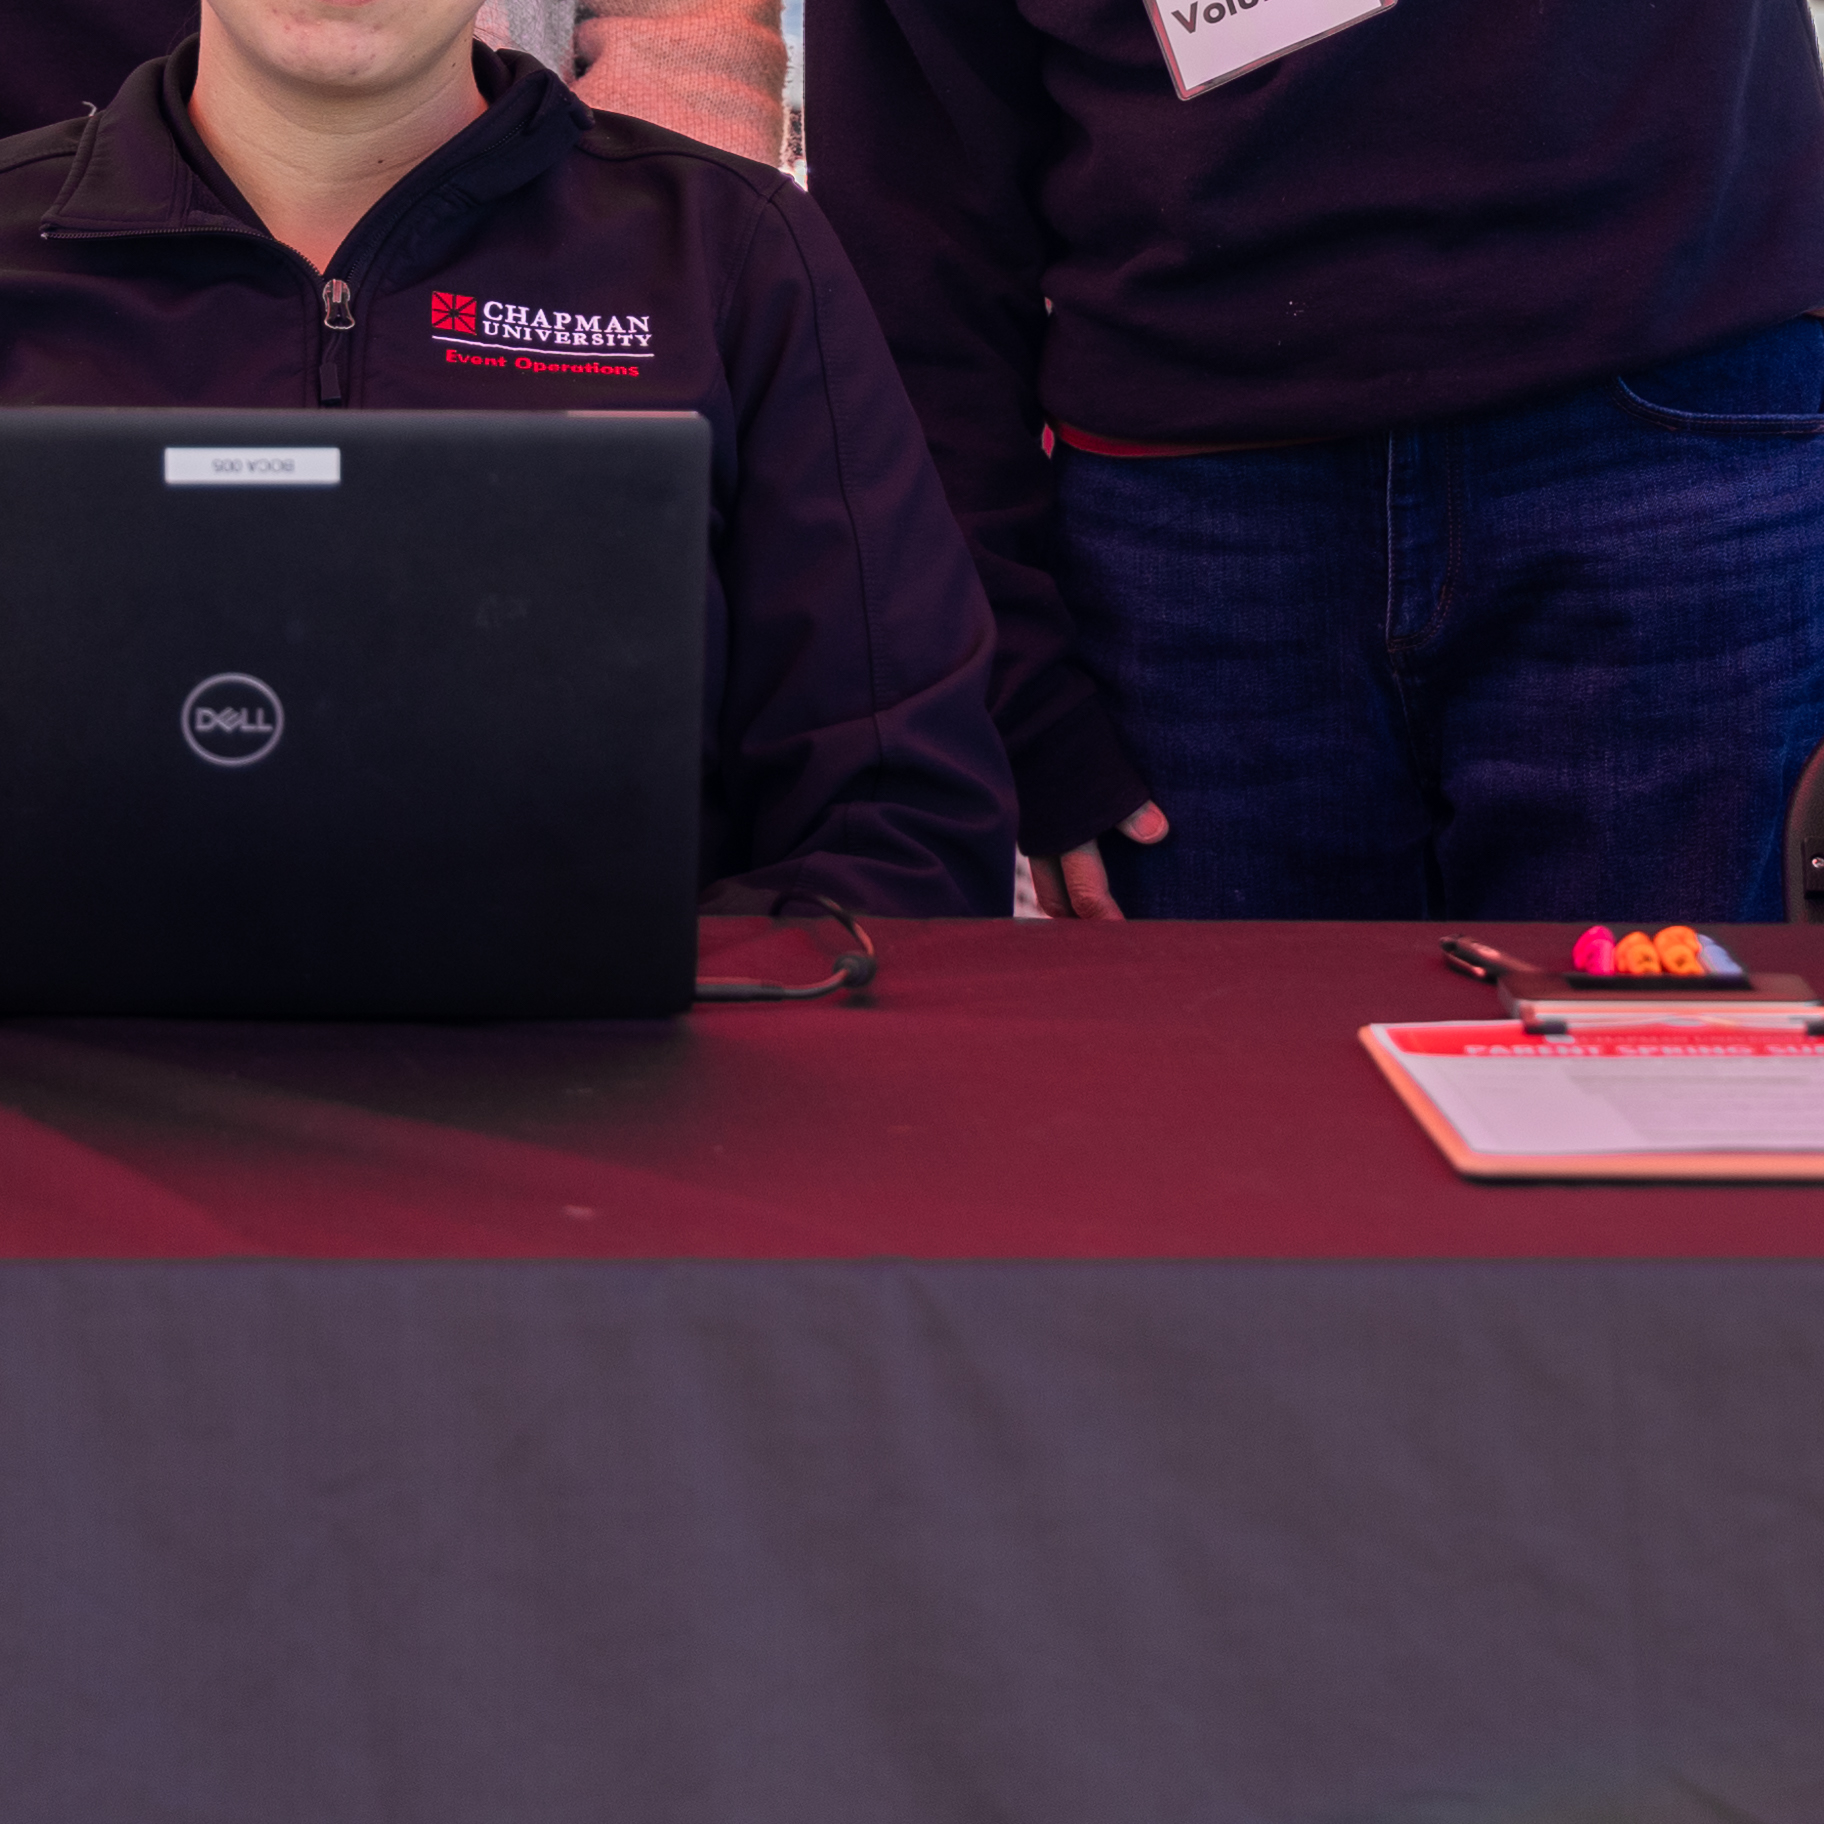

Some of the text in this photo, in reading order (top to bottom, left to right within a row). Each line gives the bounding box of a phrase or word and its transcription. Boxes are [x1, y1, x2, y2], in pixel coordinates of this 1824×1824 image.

[482, 301, 650, 333] CHAPMAN
[482, 321, 653, 347] UNIVERSITY
[445, 348, 640, 377] Event Operations
[195, 706, 274, 733] DELL
